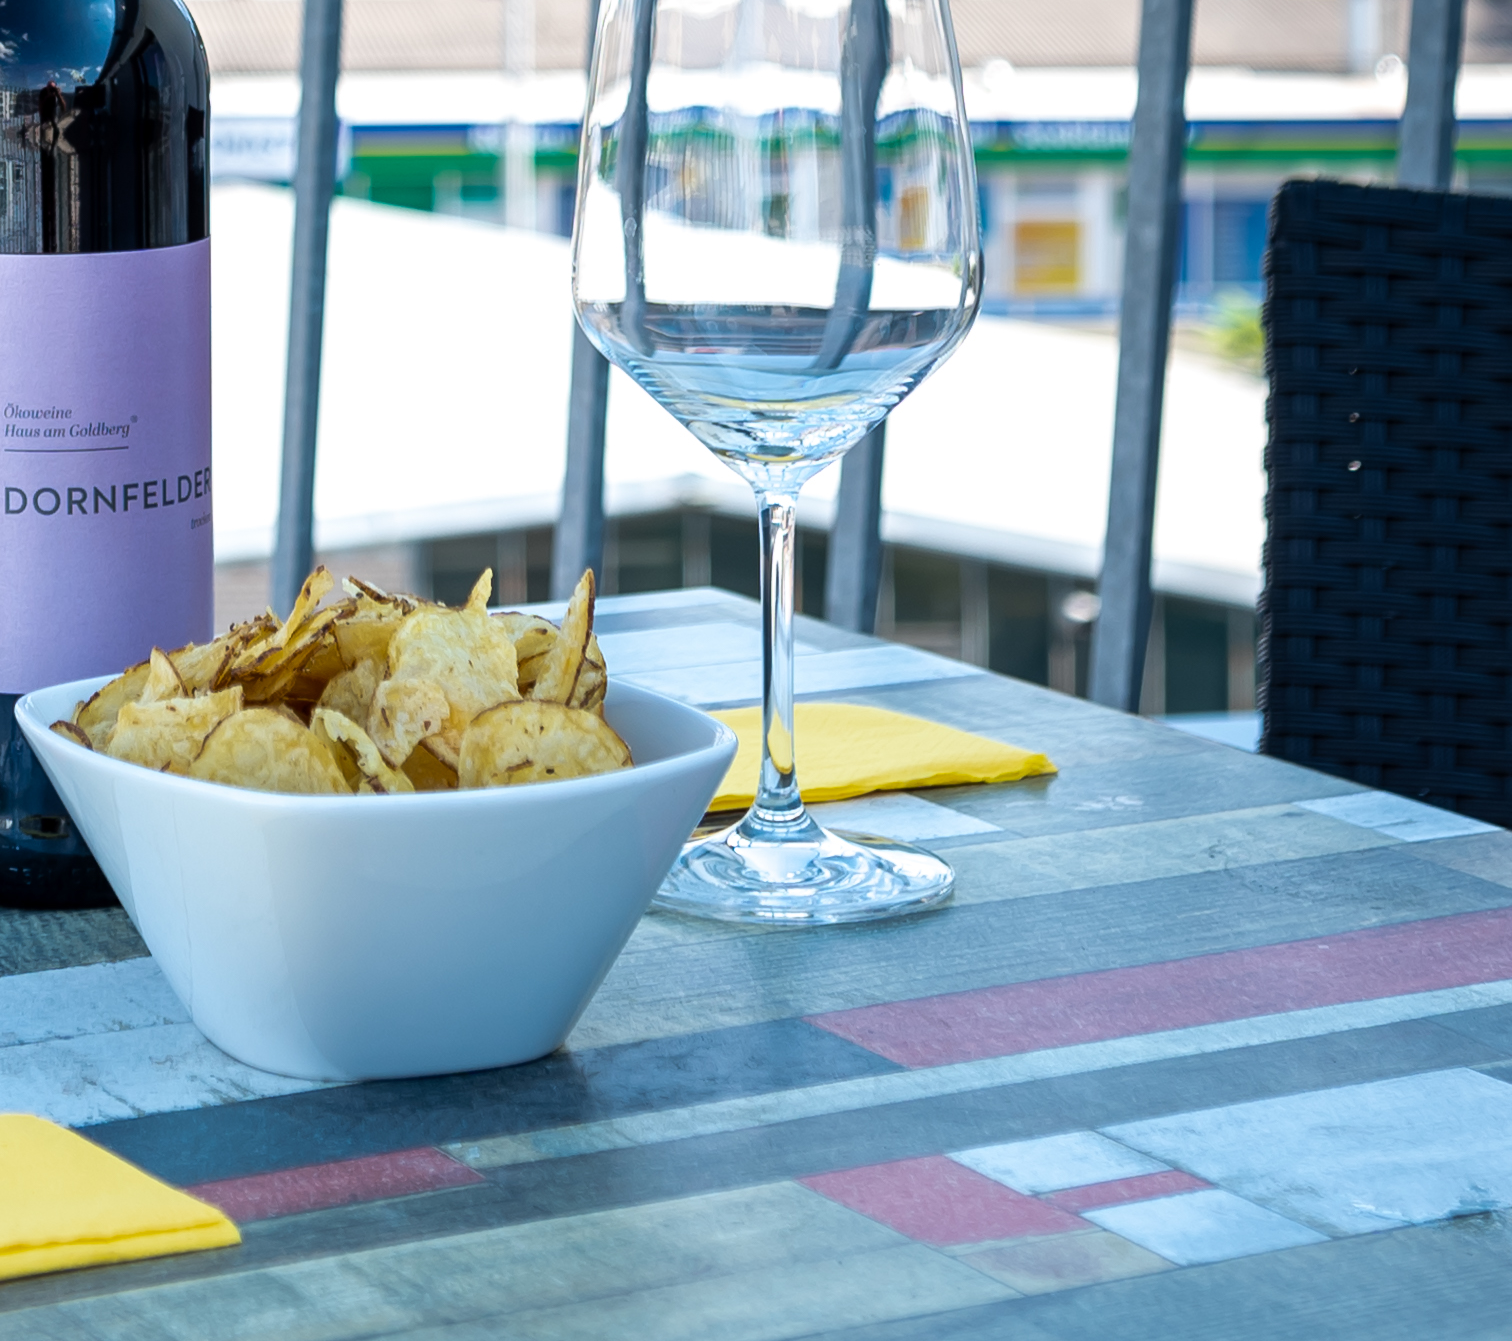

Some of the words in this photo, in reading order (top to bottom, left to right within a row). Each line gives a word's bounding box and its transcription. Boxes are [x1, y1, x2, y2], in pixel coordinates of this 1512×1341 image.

[4, 402, 72, 420] Ökoweine
[4, 423, 41, 438] Haus
[43, 427, 66, 438] am
[69, 421, 130, 438] Goldberg
[4, 466, 211, 516] DORNFELDER
